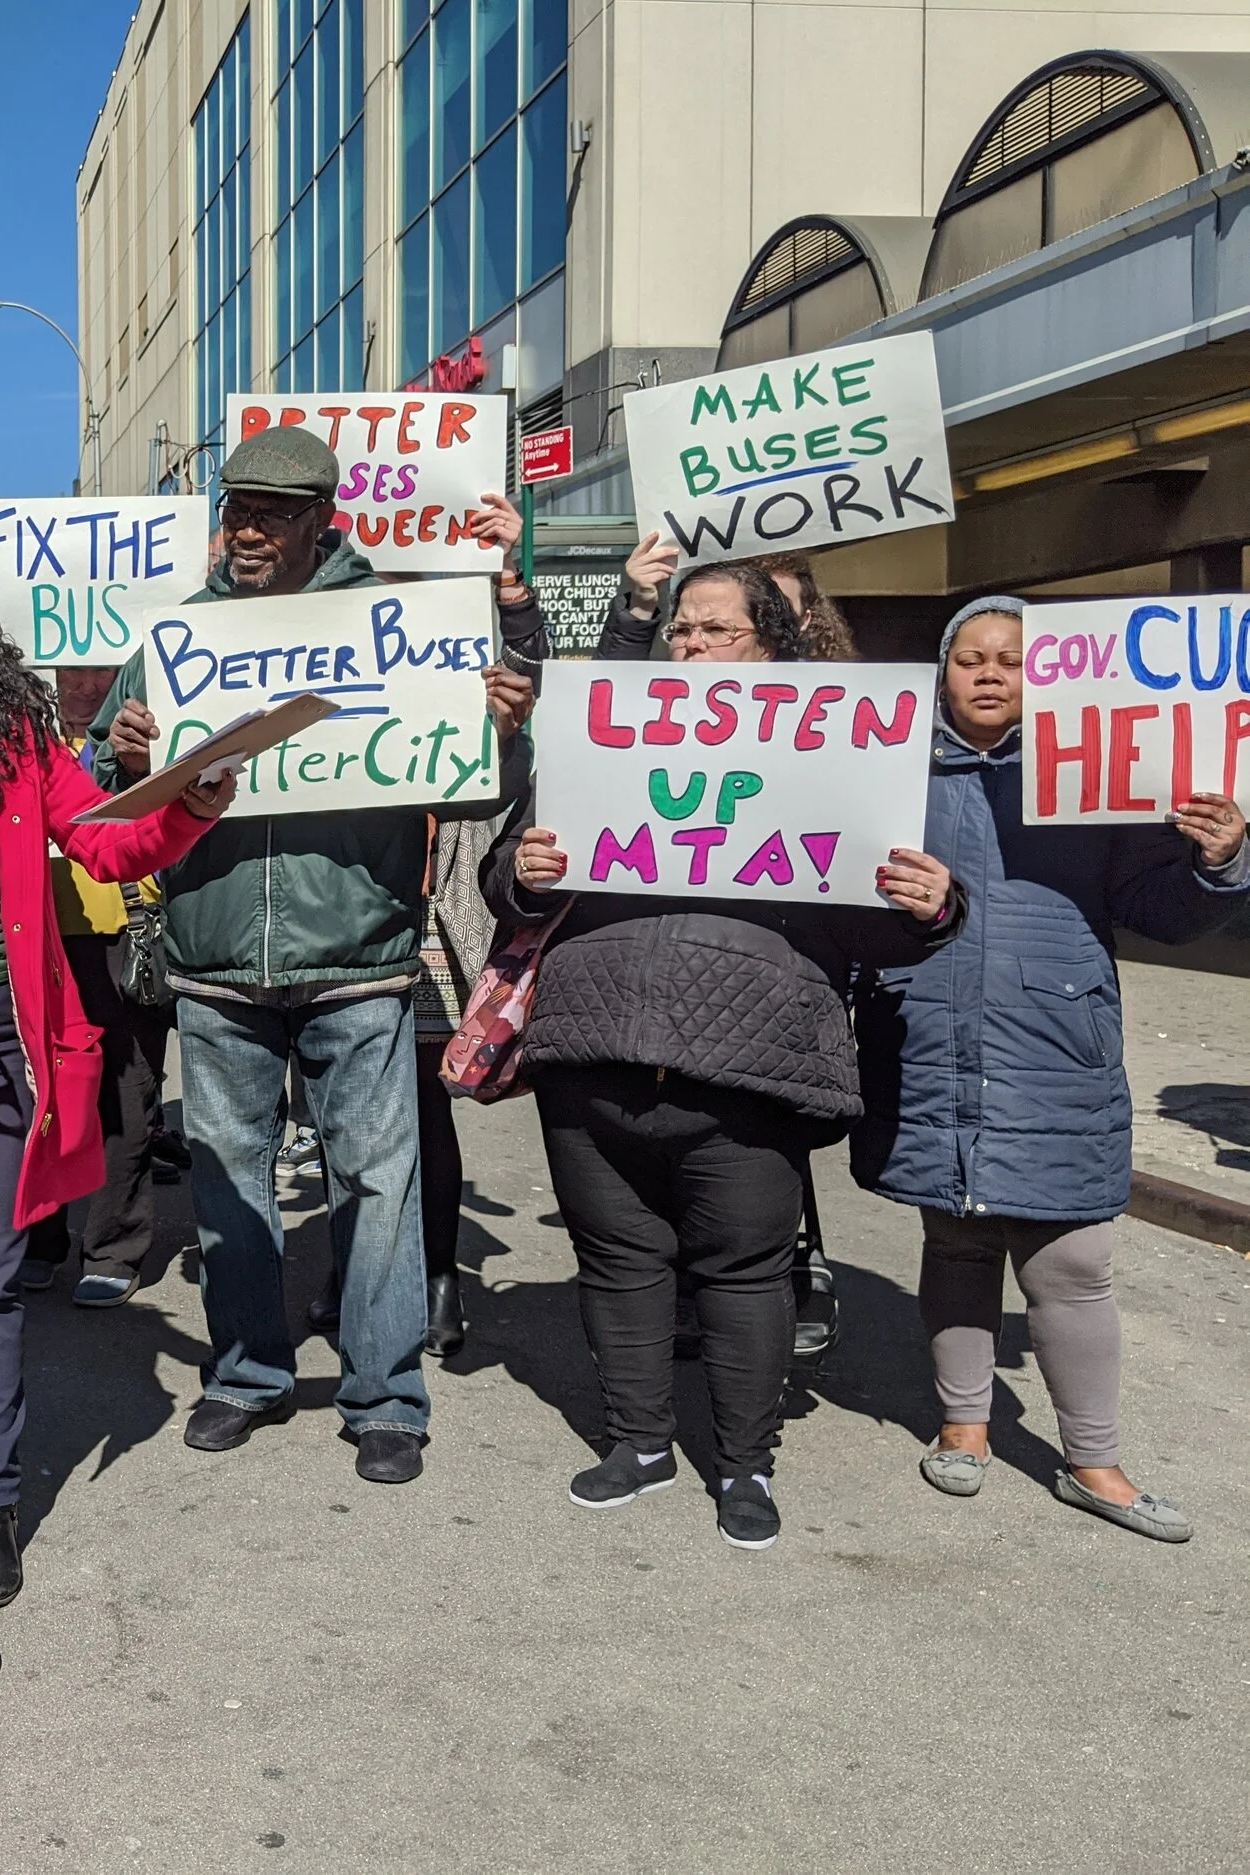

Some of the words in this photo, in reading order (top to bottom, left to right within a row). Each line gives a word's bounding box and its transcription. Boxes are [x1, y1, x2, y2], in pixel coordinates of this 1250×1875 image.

[690, 358, 875, 425] MAKE
[524, 440, 533, 450] NO
[534, 433, 564, 449] STANDING
[525, 448, 550, 461] Anytime
[680, 416, 887, 497] BUSES
[664, 457, 949, 558] WORK
[66, 511, 176, 581] THE
[567, 546, 612, 556] JCDecaux
[538, 600, 580, 612] HOOL,
[584, 599, 611, 611] BUT
[540, 588, 562, 599] MY
[564, 587, 617, 599] CHILD'S
[574, 574, 621, 586] LUNCH
[32, 584, 131, 660] BUS
[559, 611, 600, 623] CAN'T
[151, 620, 361, 707] BETTER
[371, 598, 488, 675] BUSES
[1025, 634, 1119, 686] GOV.
[588, 678, 917, 751] LISTEN
[364, 717, 497, 800] City!
[649, 768, 763, 824] UP
[590, 823, 841, 893] MTA!
